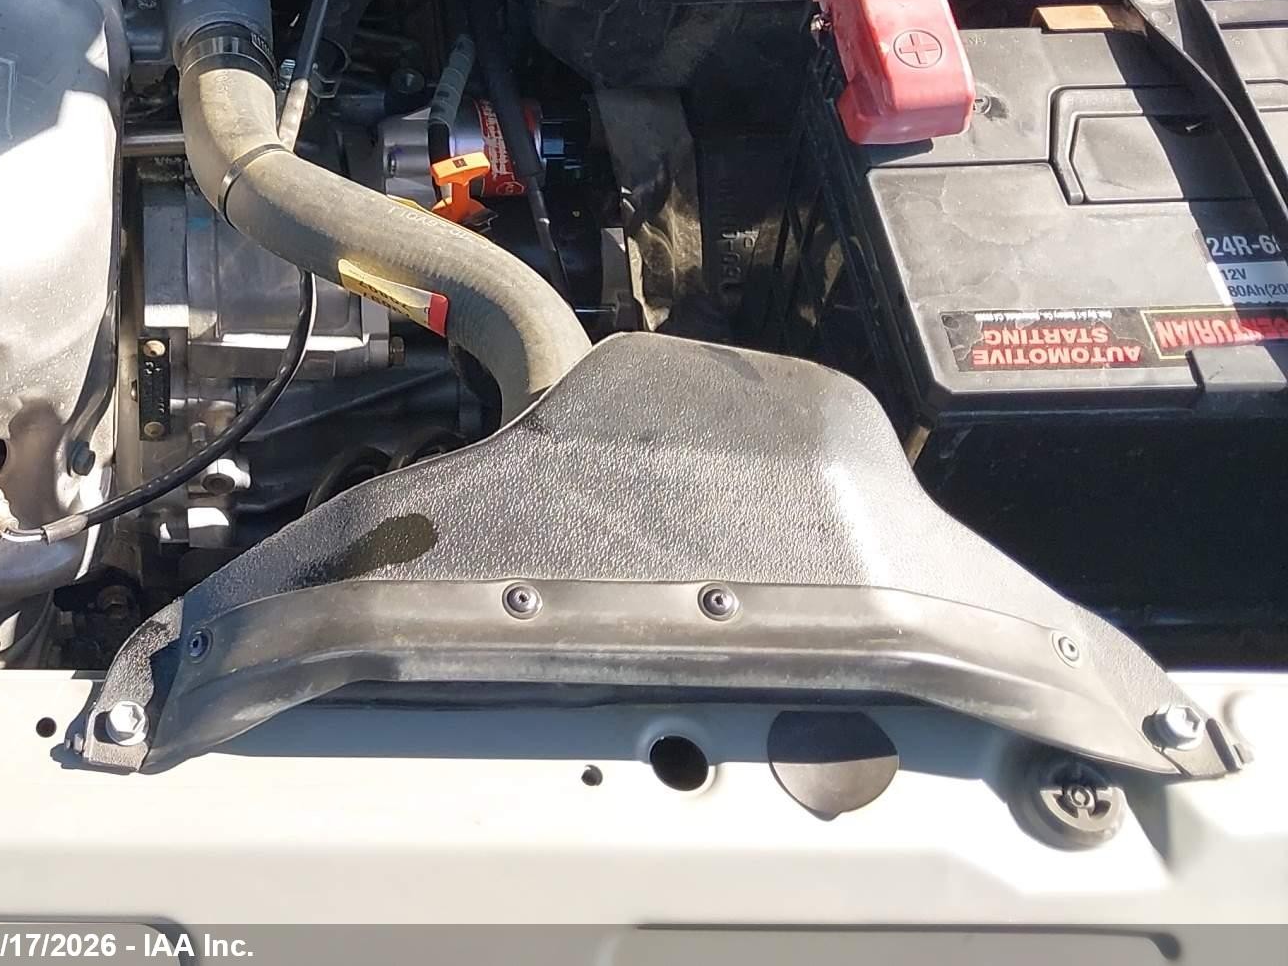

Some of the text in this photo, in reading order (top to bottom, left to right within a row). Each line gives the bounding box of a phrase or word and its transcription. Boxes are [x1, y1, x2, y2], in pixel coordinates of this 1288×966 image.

[1220, 267, 1248, 281] 12V
[1227, 283, 1288, 299] 80Ah(20
[984, 326, 1109, 345] STARTING
[973, 346, 1141, 365] AUTOMOTIVE
